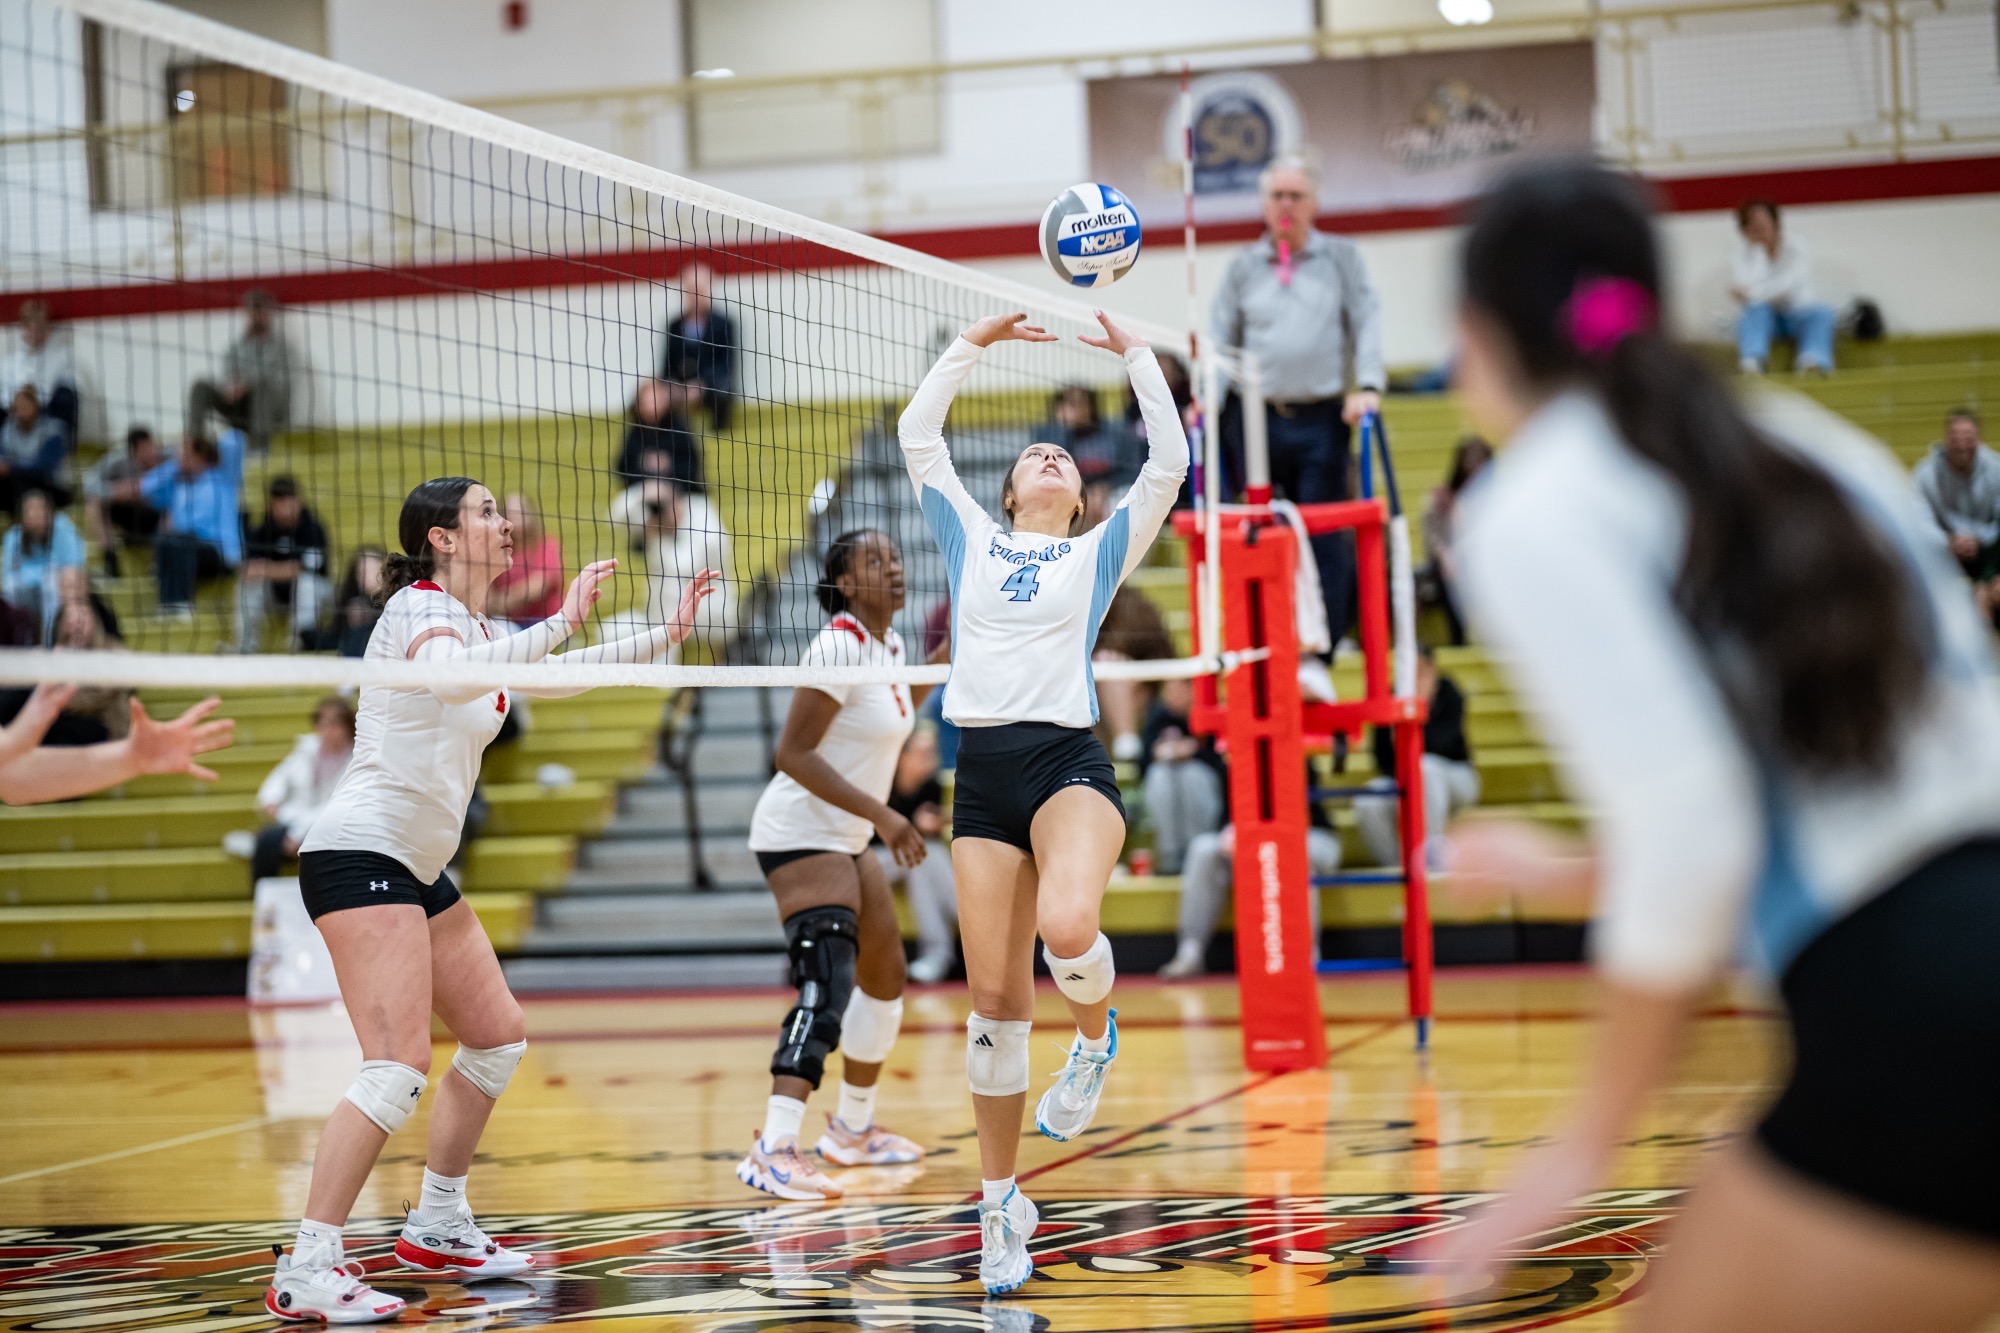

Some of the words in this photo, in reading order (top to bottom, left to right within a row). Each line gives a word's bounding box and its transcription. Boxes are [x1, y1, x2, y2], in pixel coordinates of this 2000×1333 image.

[1071, 212, 1127, 234] molten
[1080, 229, 1125, 256] NCAA
[1000, 563, 1041, 602] 4
